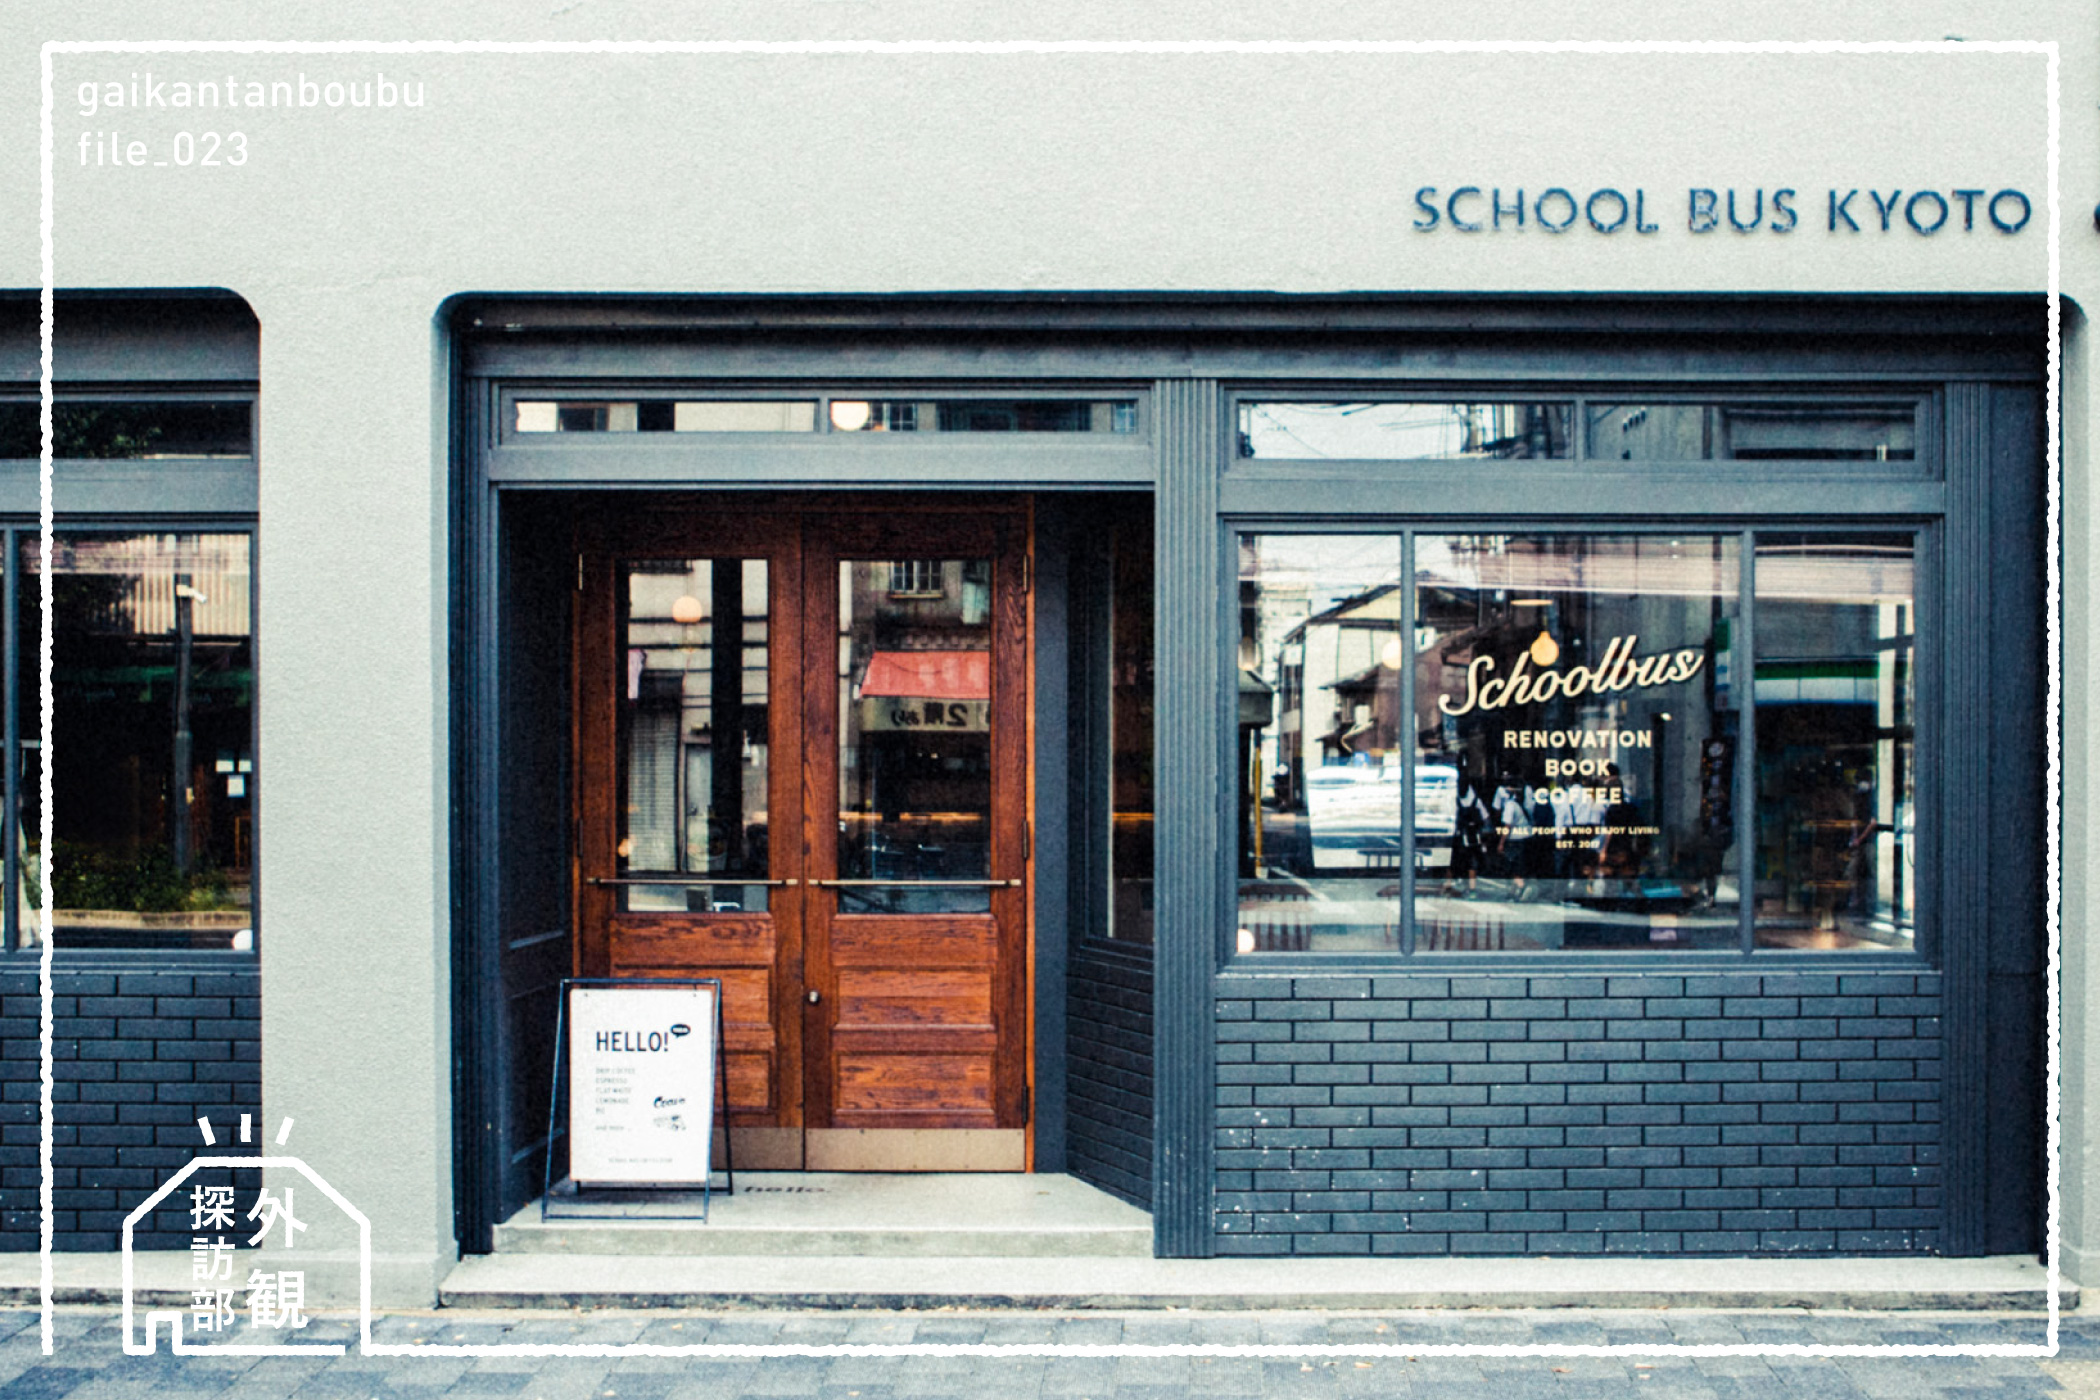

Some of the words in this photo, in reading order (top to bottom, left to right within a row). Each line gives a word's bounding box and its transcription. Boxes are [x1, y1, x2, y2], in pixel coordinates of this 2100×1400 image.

[1413, 186, 1659, 234] SCHOOL
[1688, 188, 1799, 234] BUS
[1828, 188, 2032, 235] KYOTO
[1503, 730, 1652, 749] RENOVATION
[1545, 759, 1611, 777] BOOK
[1533, 787, 1622, 805] COFFEE
[1496, 827, 1510, 835] TO
[1512, 827, 1530, 835] ALL
[1531, 827, 1567, 835] PEOPLE
[1570, 827, 1592, 835] WHO
[1595, 827, 1626, 835] ENJOY
[1628, 827, 1660, 835] LIVING
[1555, 840, 1576, 849] EST.
[596, 1031, 668, 1052] HELLO!
